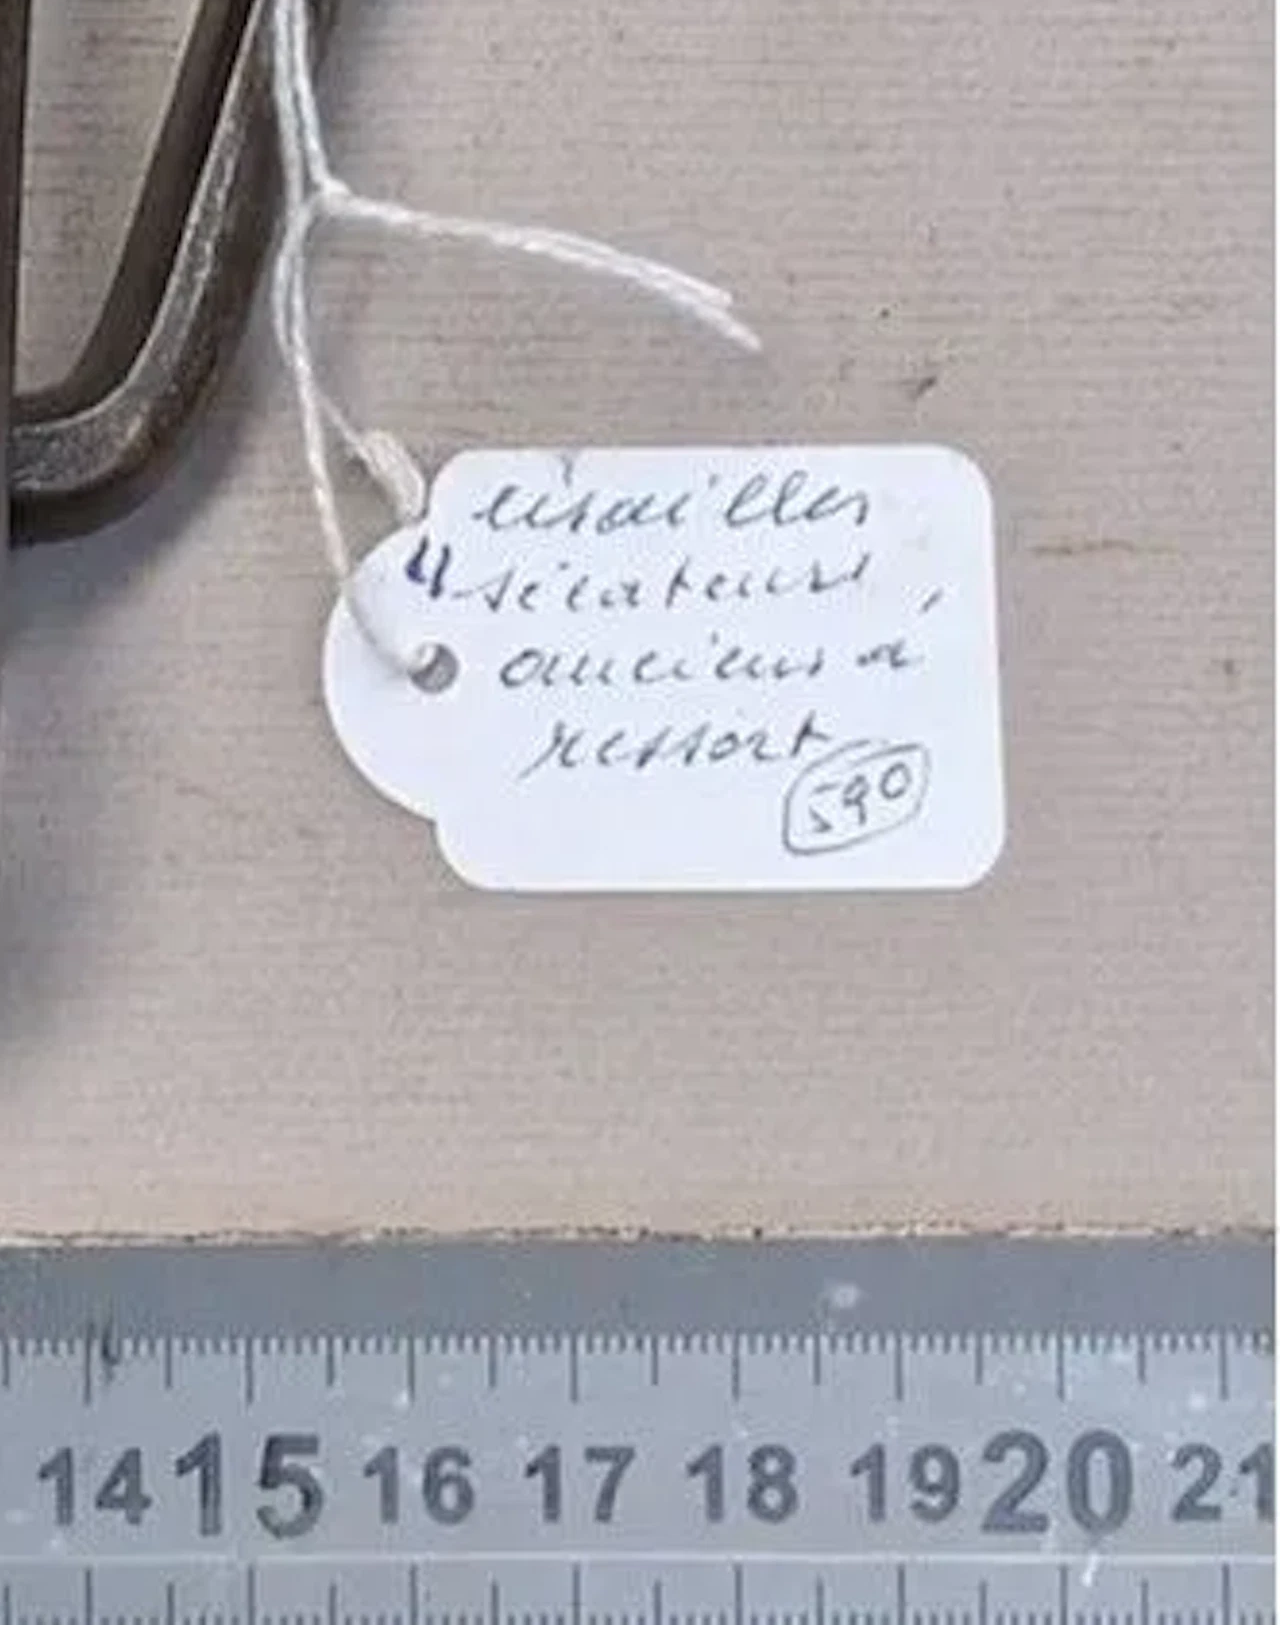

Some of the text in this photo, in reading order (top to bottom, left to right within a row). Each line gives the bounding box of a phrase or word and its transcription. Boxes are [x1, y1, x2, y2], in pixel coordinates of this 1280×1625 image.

[516, 709, 832, 782] ressort
[38, 1447, 152, 1525] 14
[176, 1434, 322, 1538] 15
[364, 1447, 474, 1524] 16
[525, 1445, 634, 1523] 17
[687, 1445, 797, 1523] 18
[851, 1444, 960, 1523] 19
[982, 1430, 1132, 1536] 20
[1171, 1444, 1274, 1522] 21
